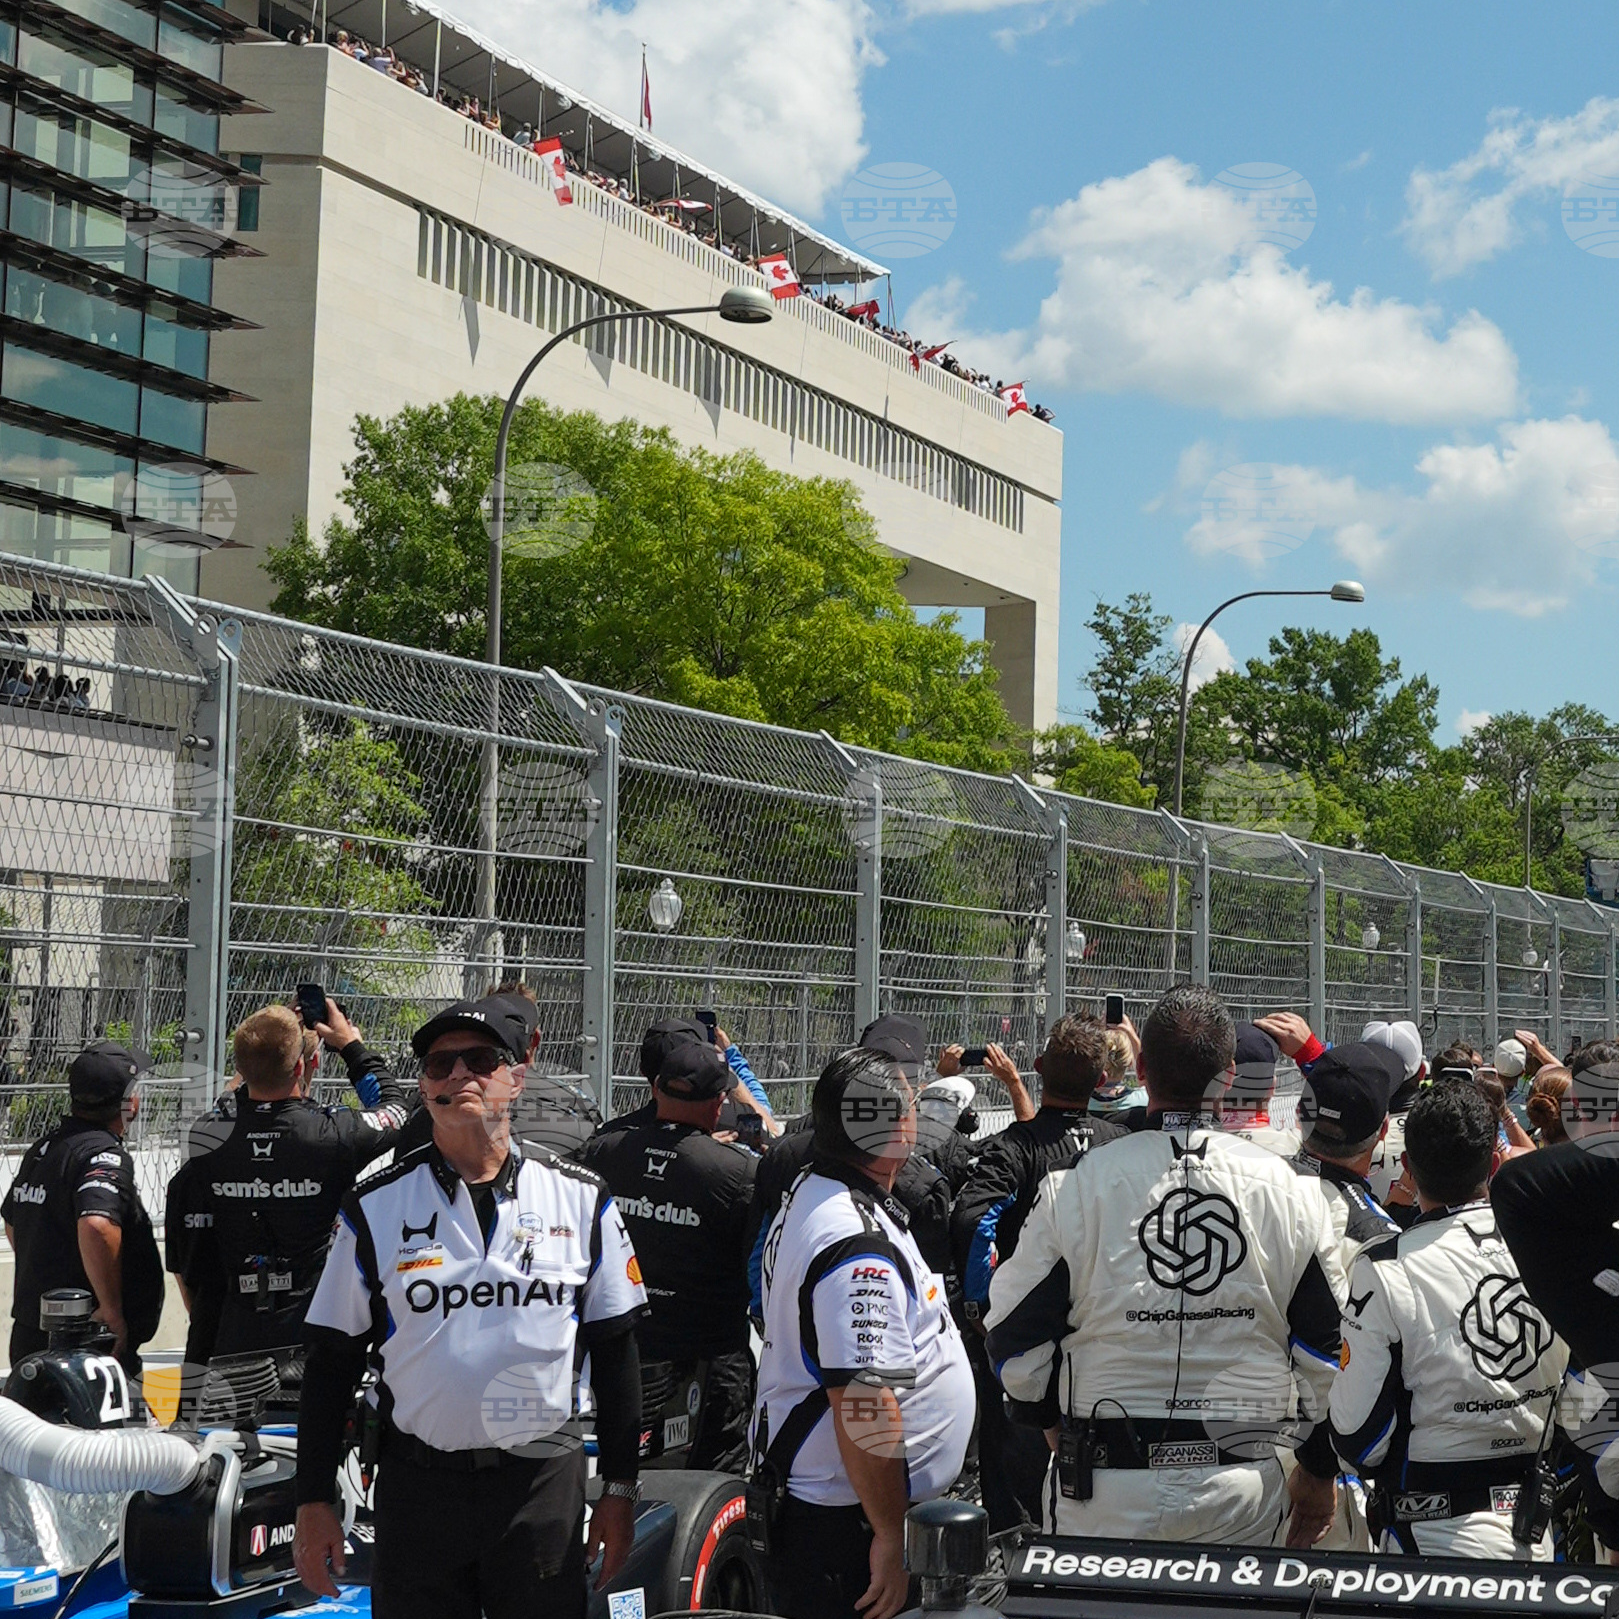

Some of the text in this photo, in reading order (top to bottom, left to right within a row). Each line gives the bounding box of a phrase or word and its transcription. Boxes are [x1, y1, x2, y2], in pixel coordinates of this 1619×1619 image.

[211, 1177, 322, 1199] sam's club
[654, 1202, 701, 1228] club
[851, 1267, 890, 1281] HRC
[405, 1278, 567, 1319] OpenAI
[850, 1288, 892, 1299] DHL
[867, 1303, 889, 1315] PNC
[1164, 1397, 1211, 1411] sparco
[1021, 1546, 1221, 1585] Research
[1231, 1554, 1264, 1584] &
[1272, 1558, 1547, 1605] Deployment
